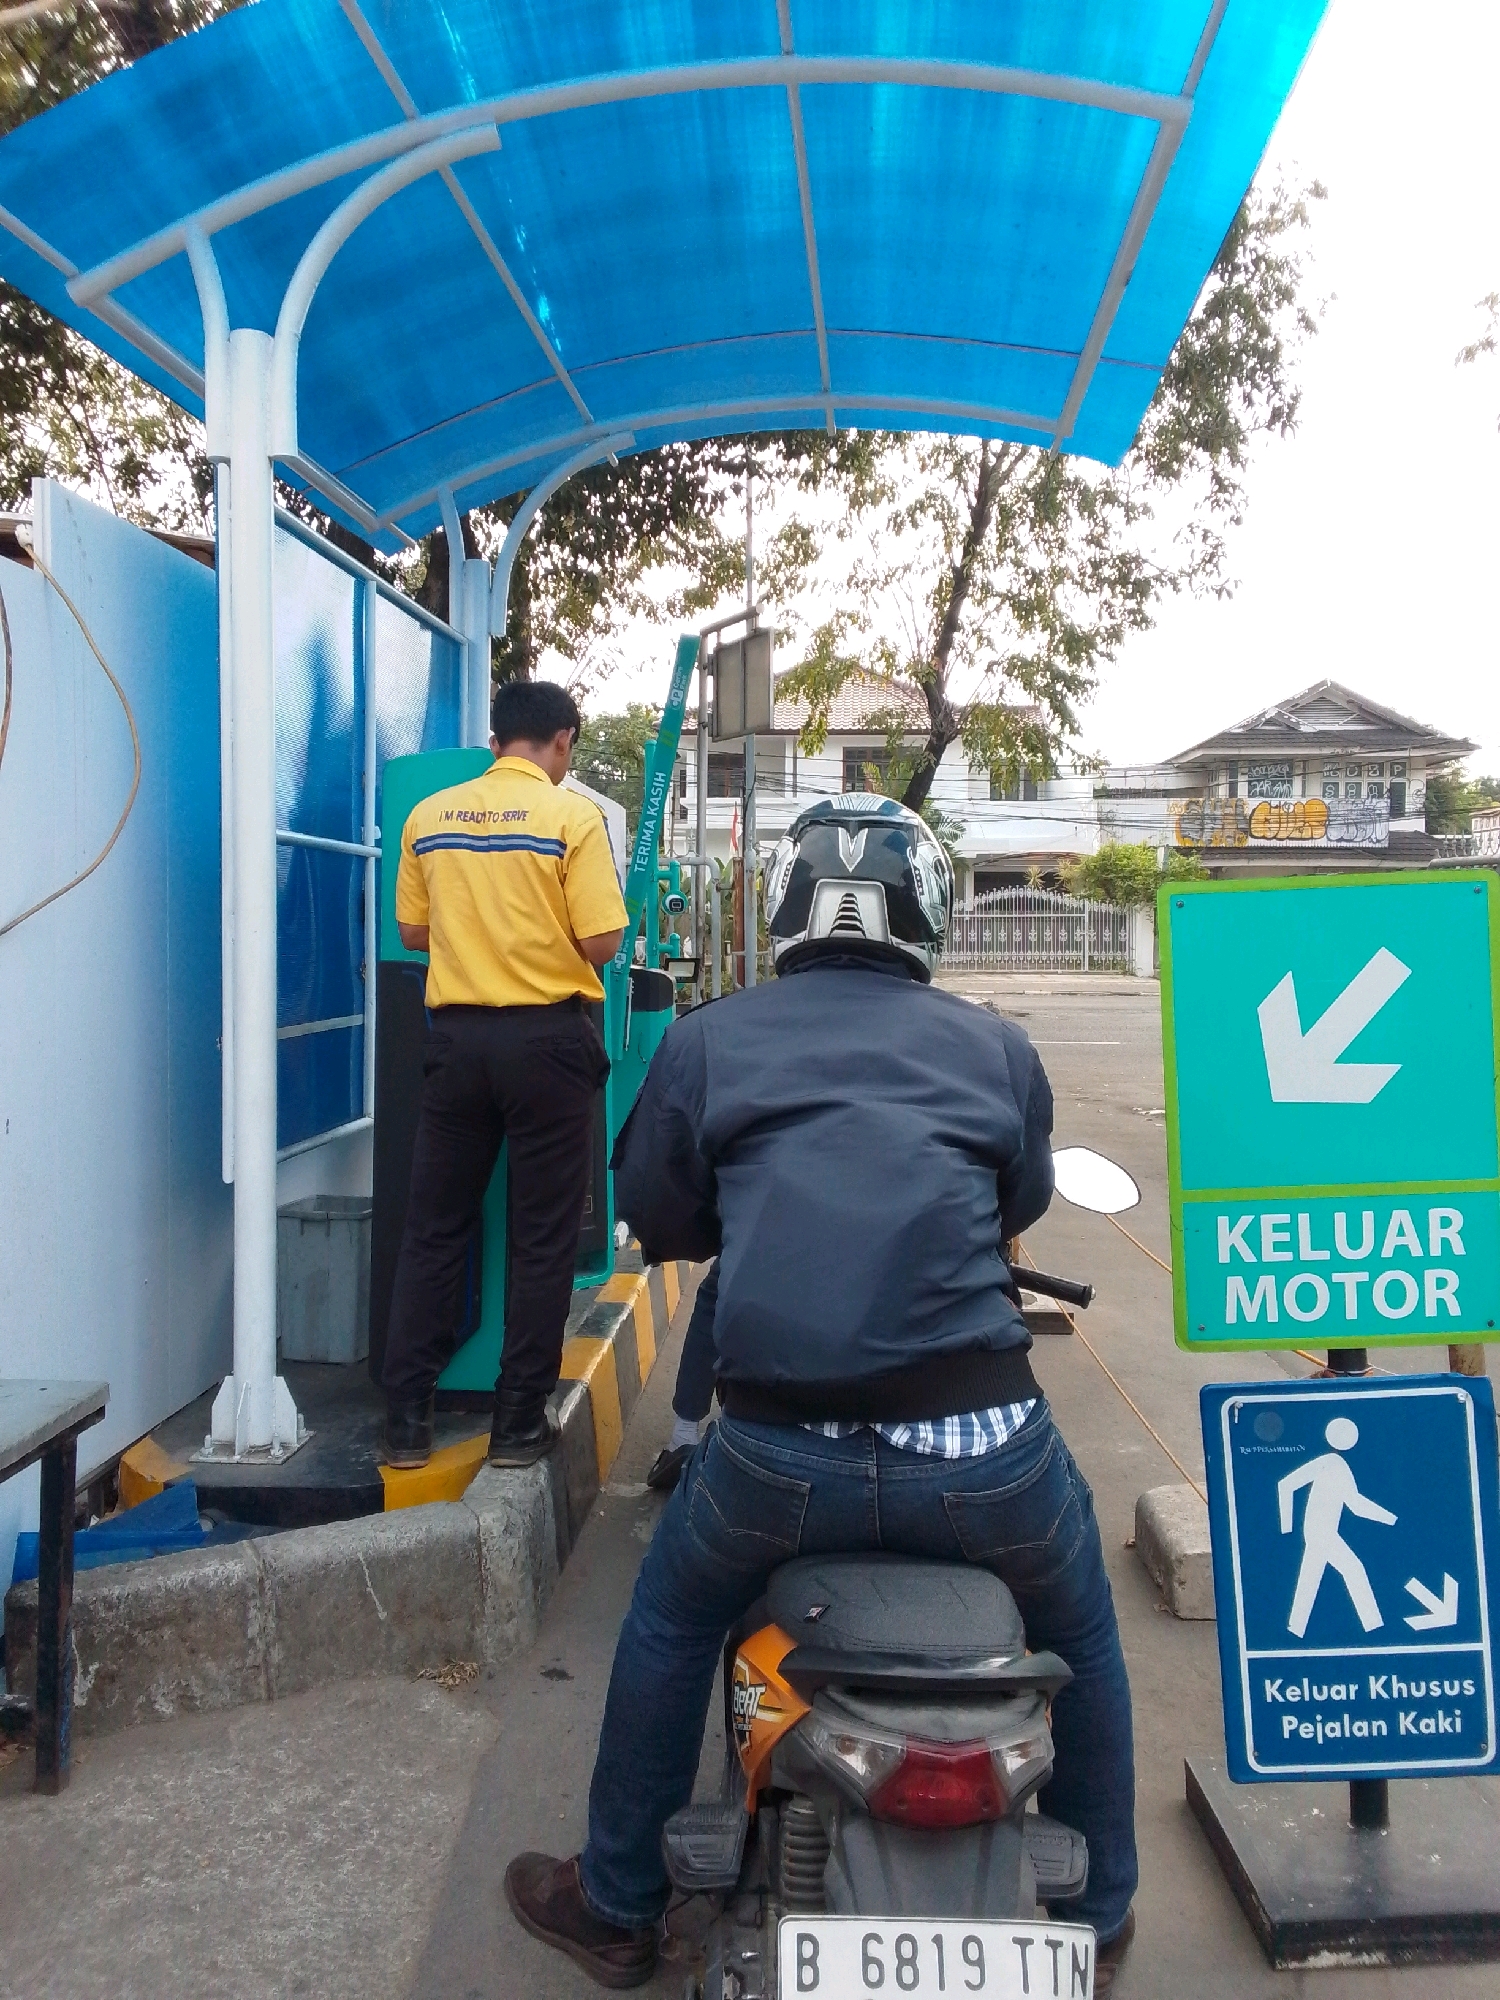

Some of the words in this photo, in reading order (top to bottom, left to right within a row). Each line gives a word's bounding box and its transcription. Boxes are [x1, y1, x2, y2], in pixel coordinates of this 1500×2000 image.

[439, 810, 454, 822] I'M
[487, 810, 500, 823] TO
[500, 809, 529, 822] SERVE
[634, 820, 657, 873] TERIMA
[646, 772, 666, 816] KASIH
[1216, 1207, 1467, 1264] KELUAR
[1225, 1268, 1462, 1324] MOTOR
[1264, 1677, 1359, 1703] Keluar
[1368, 1674, 1476, 1700] Khusus
[1281, 1713, 1388, 1745] Pejalan
[1399, 1709, 1462, 1736] Kaki
[796, 1932, 820, 1993] B
[861, 1932, 986, 1992] 6819
[1011, 1936, 1089, 1998] TTN
